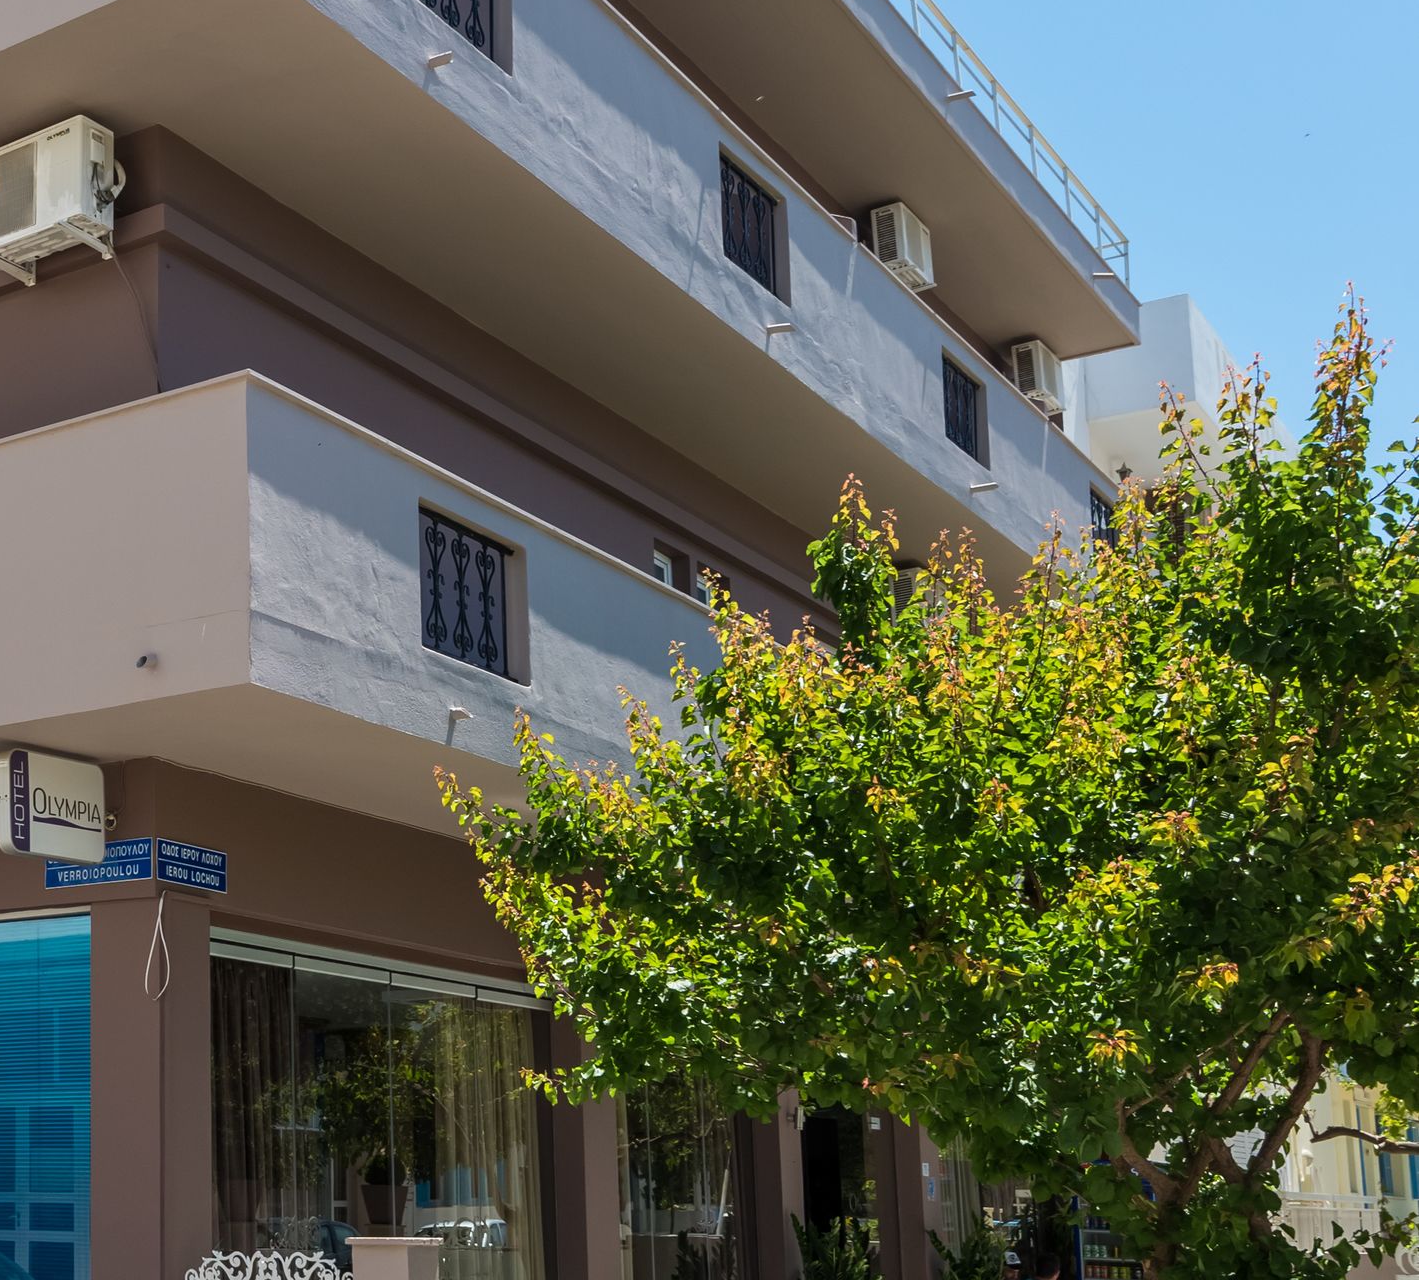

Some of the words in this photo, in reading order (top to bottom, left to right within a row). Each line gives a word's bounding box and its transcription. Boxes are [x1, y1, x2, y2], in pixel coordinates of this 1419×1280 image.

[13, 761, 25, 840] HOTEL
[161, 843, 180, 858] ΟΔΟΣ
[180, 847, 200, 862] ΙΕΡΟΥ
[201, 852, 223, 867] ΛΟΧΟΥ
[57, 864, 139, 882] VERROIOPOULOU
[165, 864, 188, 880] IEROU
[191, 870, 220, 887] LOCHOU
